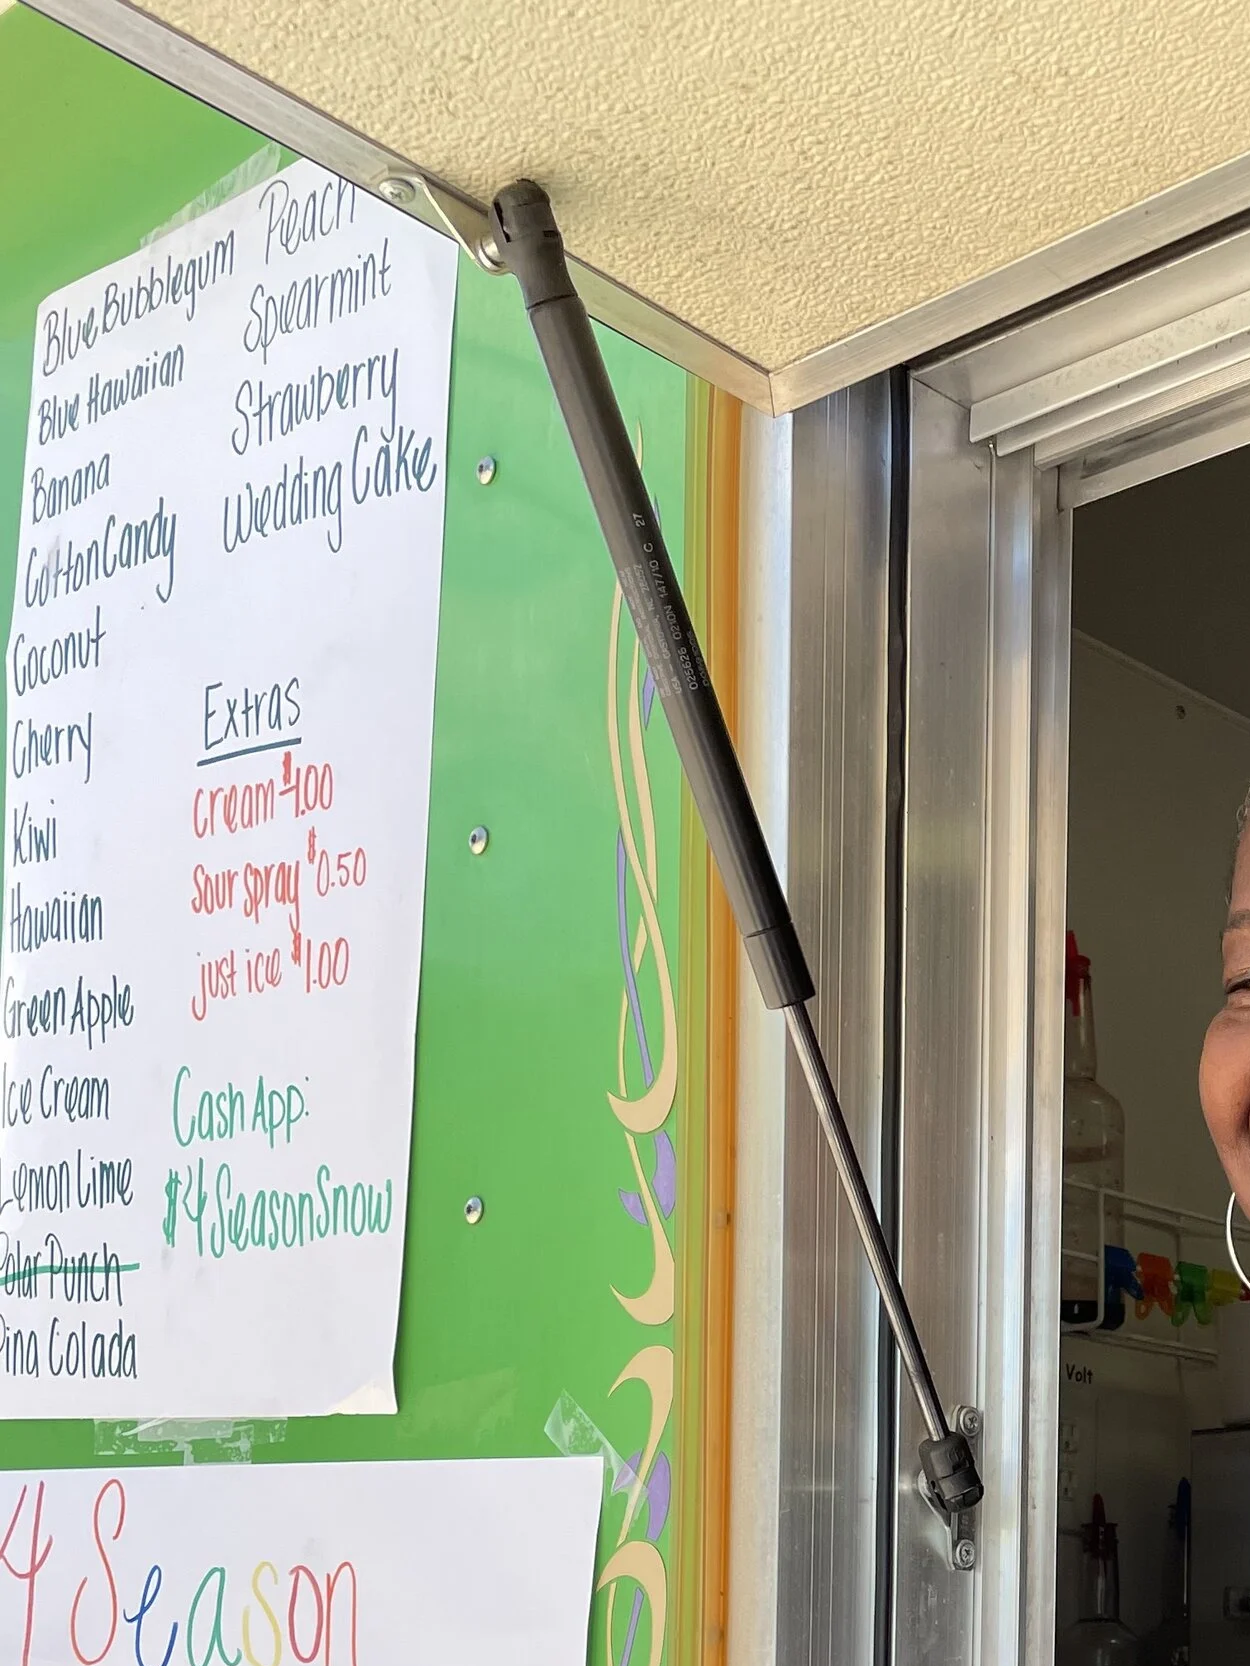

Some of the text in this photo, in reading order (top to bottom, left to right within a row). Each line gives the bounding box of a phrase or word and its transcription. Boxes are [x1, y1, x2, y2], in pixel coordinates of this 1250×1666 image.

[258, 178, 356, 265] Peach
[43, 229, 235, 377] Blue Bubblegum
[243, 237, 392, 366] Spearmint
[38, 344, 184, 446] Blue Hawaiian
[231, 347, 399, 456] Strawberry
[31, 453, 110, 525] Banana
[352, 424, 438, 505] Cake
[14, 605, 107, 697] Coconut
[13, 712, 92, 785] Cherry
[204, 677, 301, 751] Extras
[13, 798, 57, 868] Kiwi
[10, 881, 103, 953] Hawaiian
[245, 947, 283, 994] ice
[3, 975, 135, 1051] Green Apple
[1, 1062, 110, 1129] Ice Cream
[172, 1065, 246, 1148] Cash
[45, 1232, 123, 1307] Punch
[49, 1317, 138, 1379] Colada
[1066, 1363, 1093, 1385] Volt
